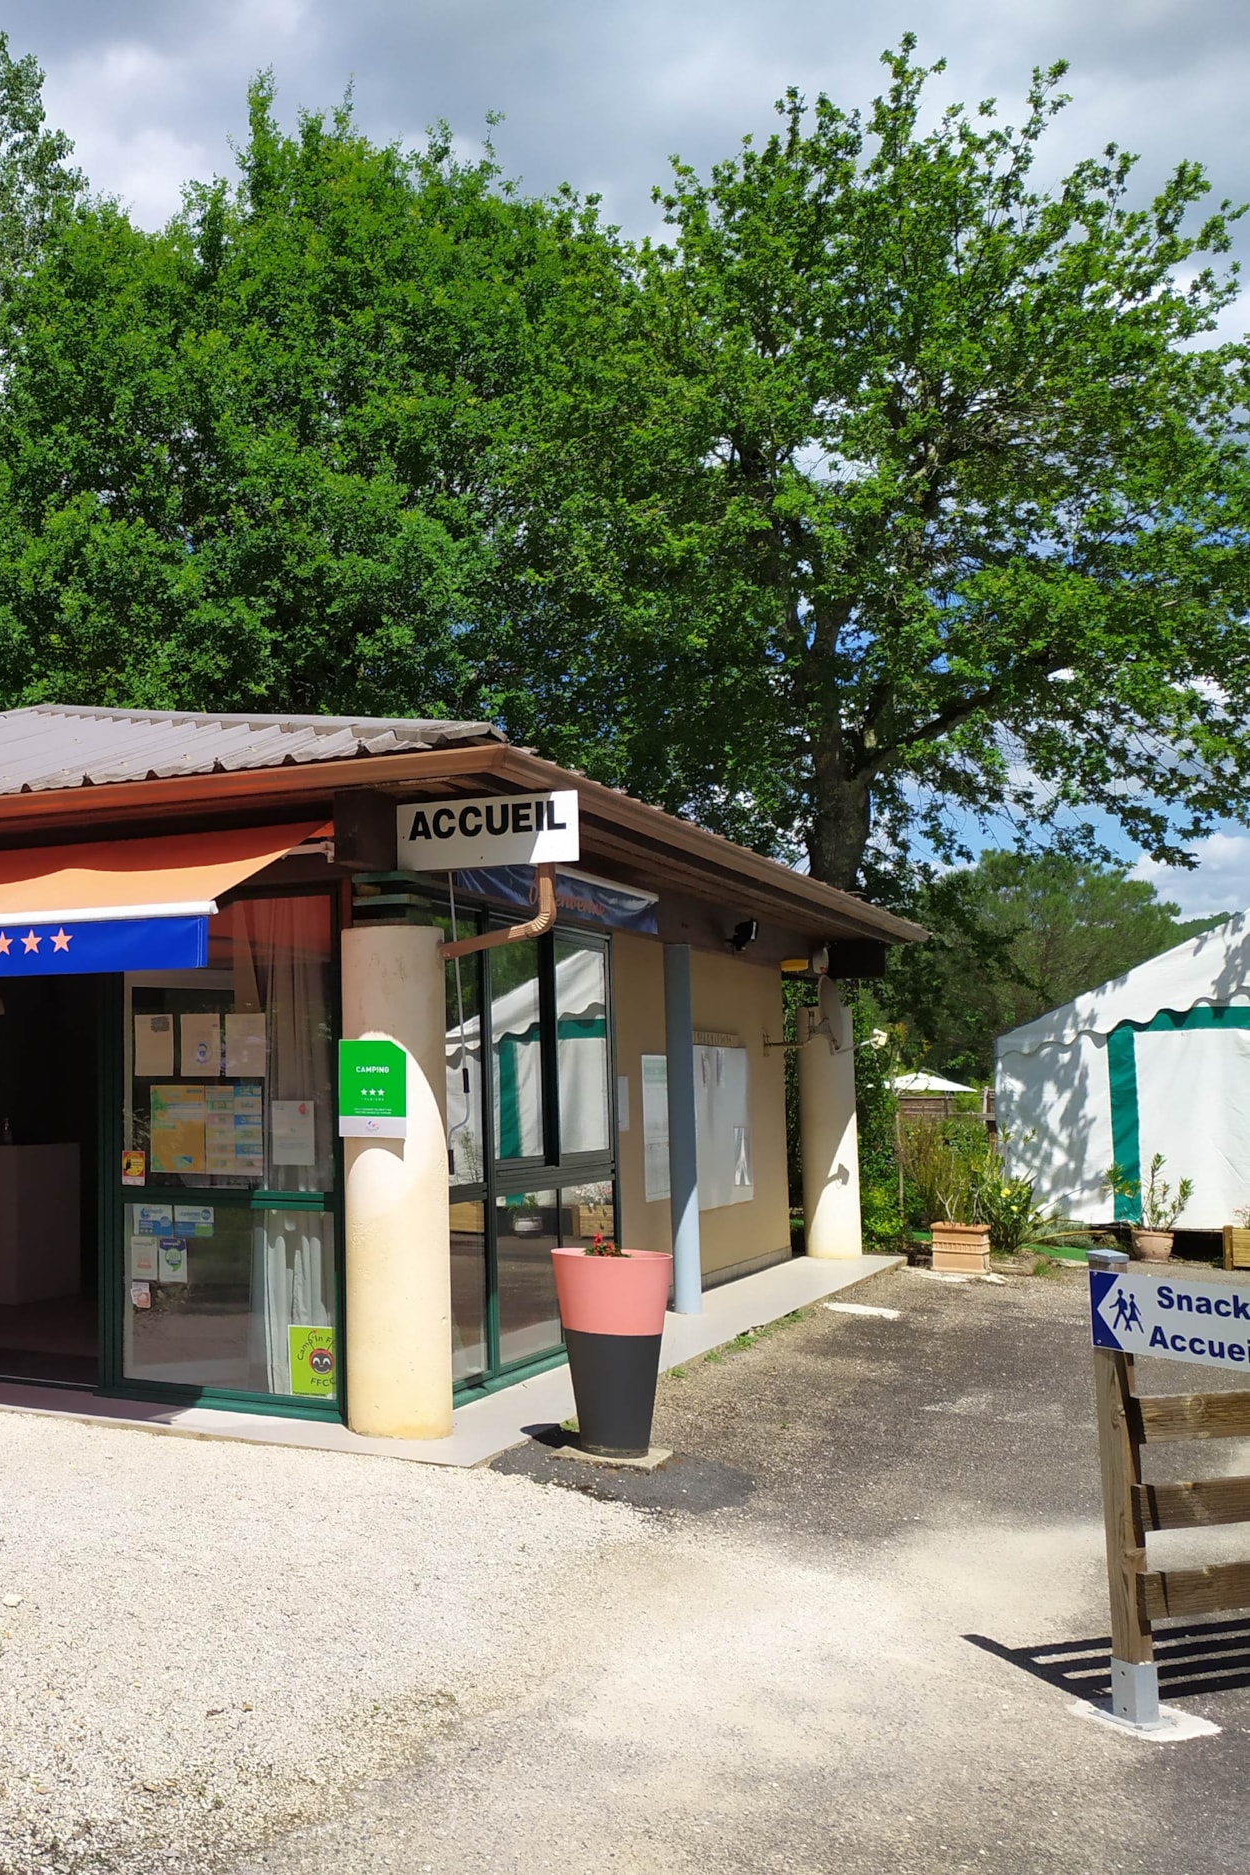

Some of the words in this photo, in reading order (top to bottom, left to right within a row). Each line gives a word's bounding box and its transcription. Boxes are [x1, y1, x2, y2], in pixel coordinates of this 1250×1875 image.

[409, 800, 567, 841] ACCUEIL
[355, 1066, 390, 1074] CAMPING
[1156, 1285, 1250, 1321] Snack
